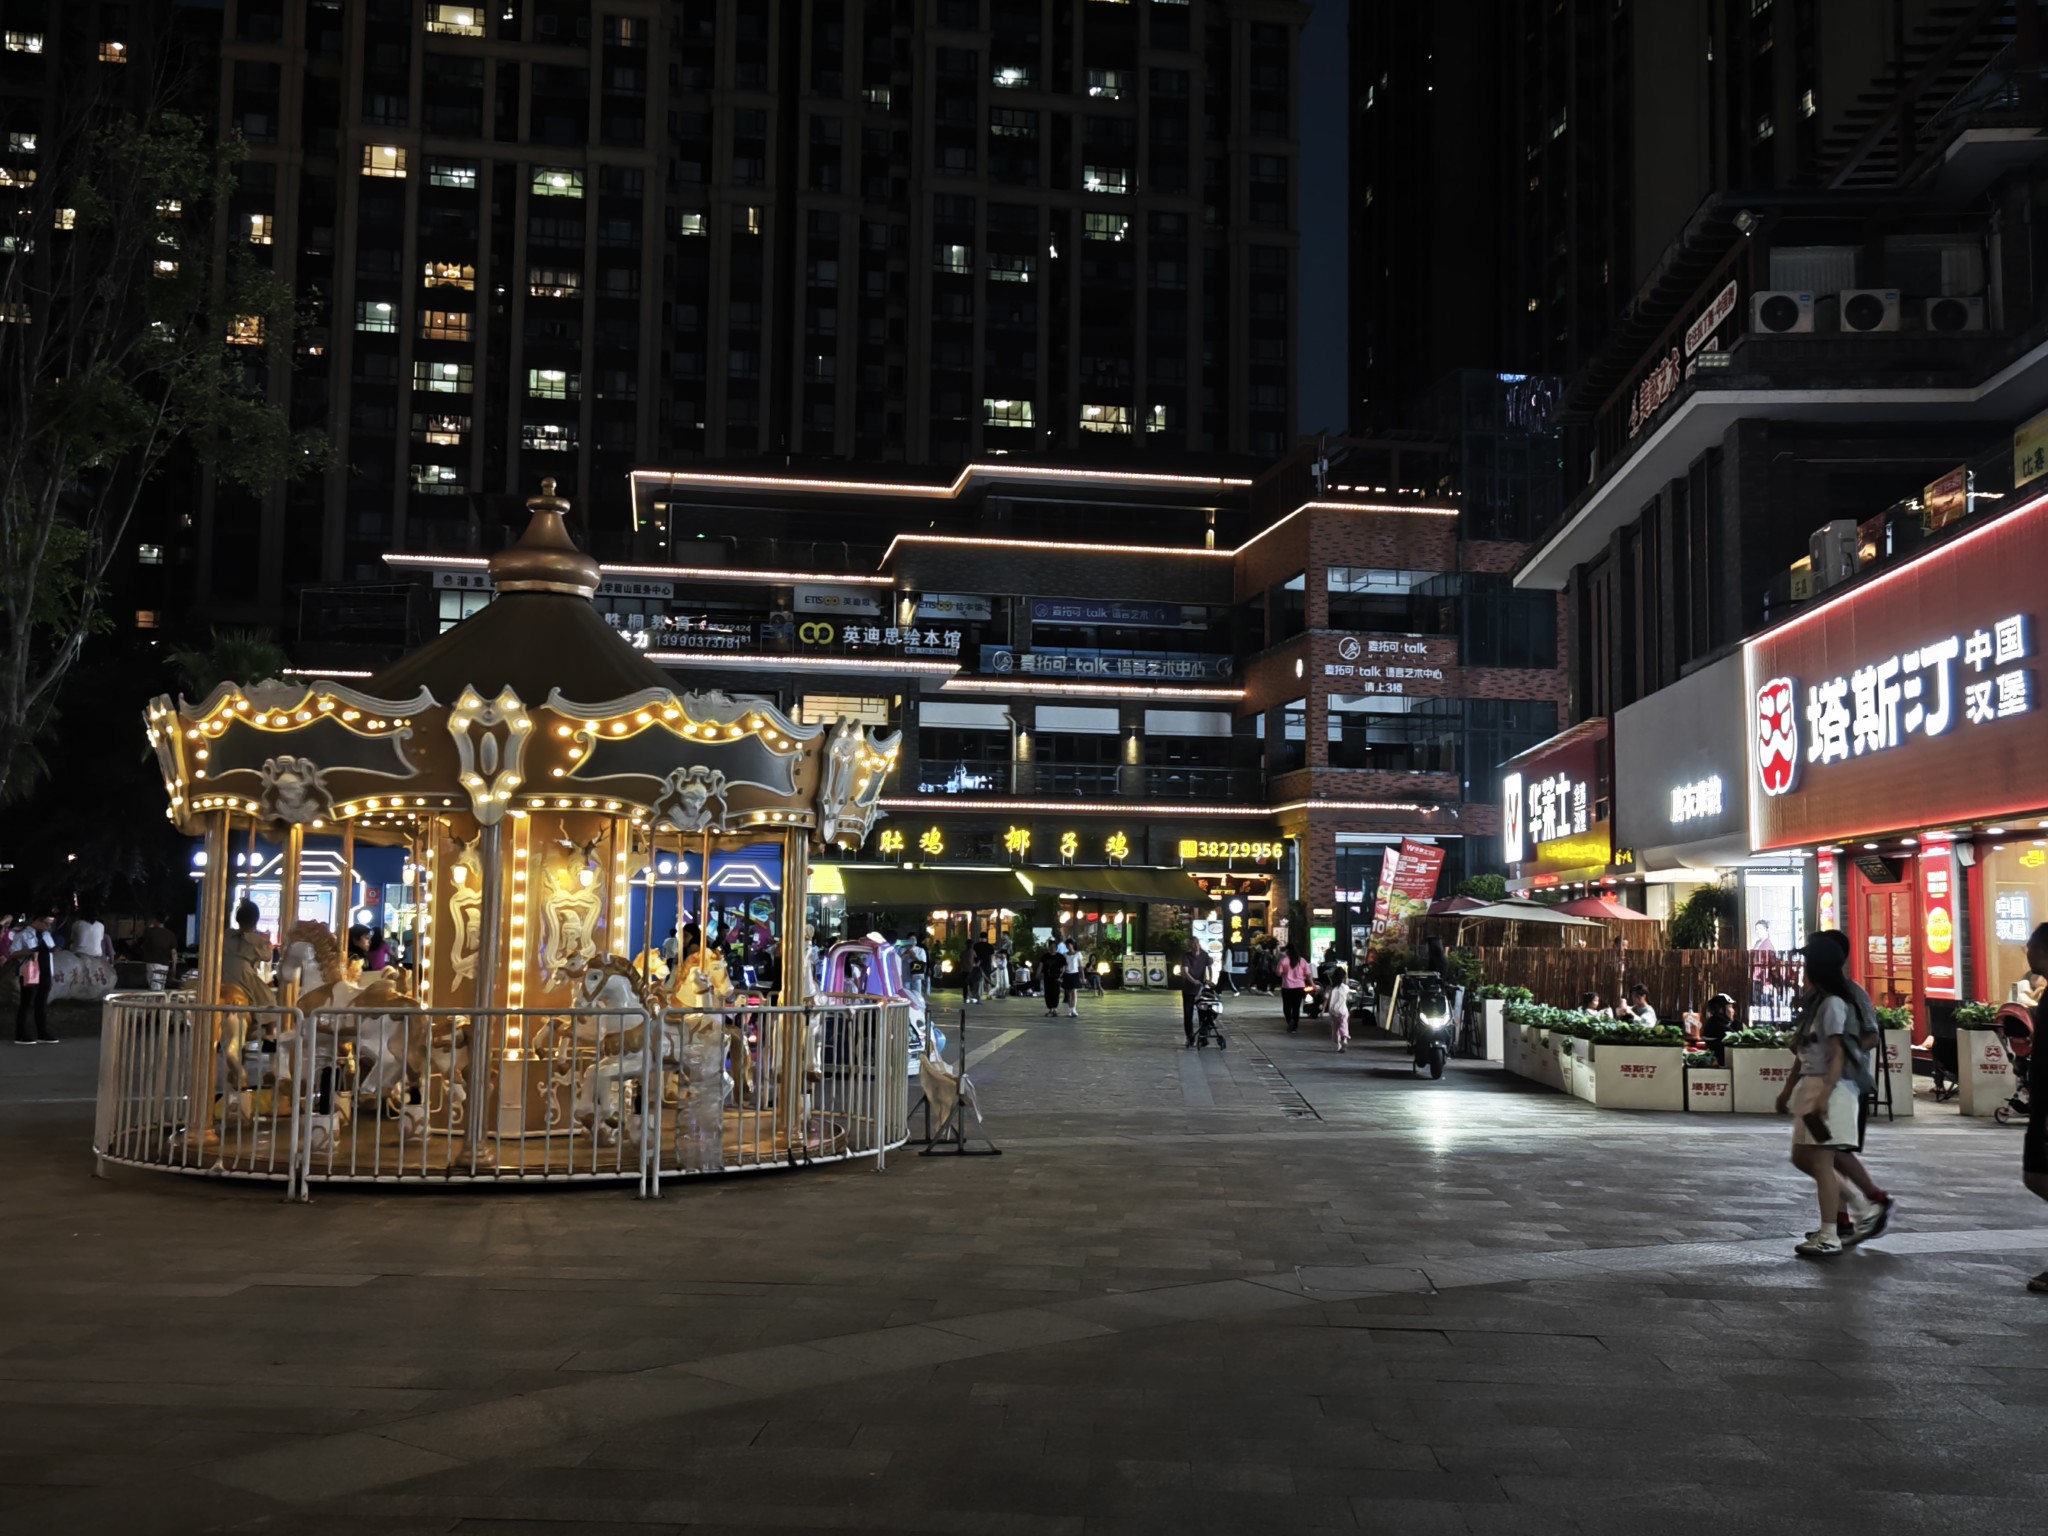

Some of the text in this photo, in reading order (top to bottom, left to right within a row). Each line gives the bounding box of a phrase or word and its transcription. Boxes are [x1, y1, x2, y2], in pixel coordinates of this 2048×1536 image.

[655, 634, 740, 650] 13990373781
[842, 625, 963, 649] 英迪思绘本馆
[1964, 614, 2025, 672] 中国
[1118, 657, 1206, 678] 语言艺术中心
[1385, 666, 1443, 680] 语言艺术中心
[1364, 681, 1404, 693] 请上3楼
[1965, 669, 2030, 724] 汉堡
[1807, 635, 1959, 765] 塔斯汀
[1528, 772, 1571, 844] 华莱士
[880, 829, 944, 855] 肚鸡
[1004, 826, 1129, 858] 椰子鸡
[1198, 841, 1284, 858] 38229956
[1620, 1064, 1657, 1073] 塔斯汀
[1691, 1082, 1729, 1091] 塔斯汀
